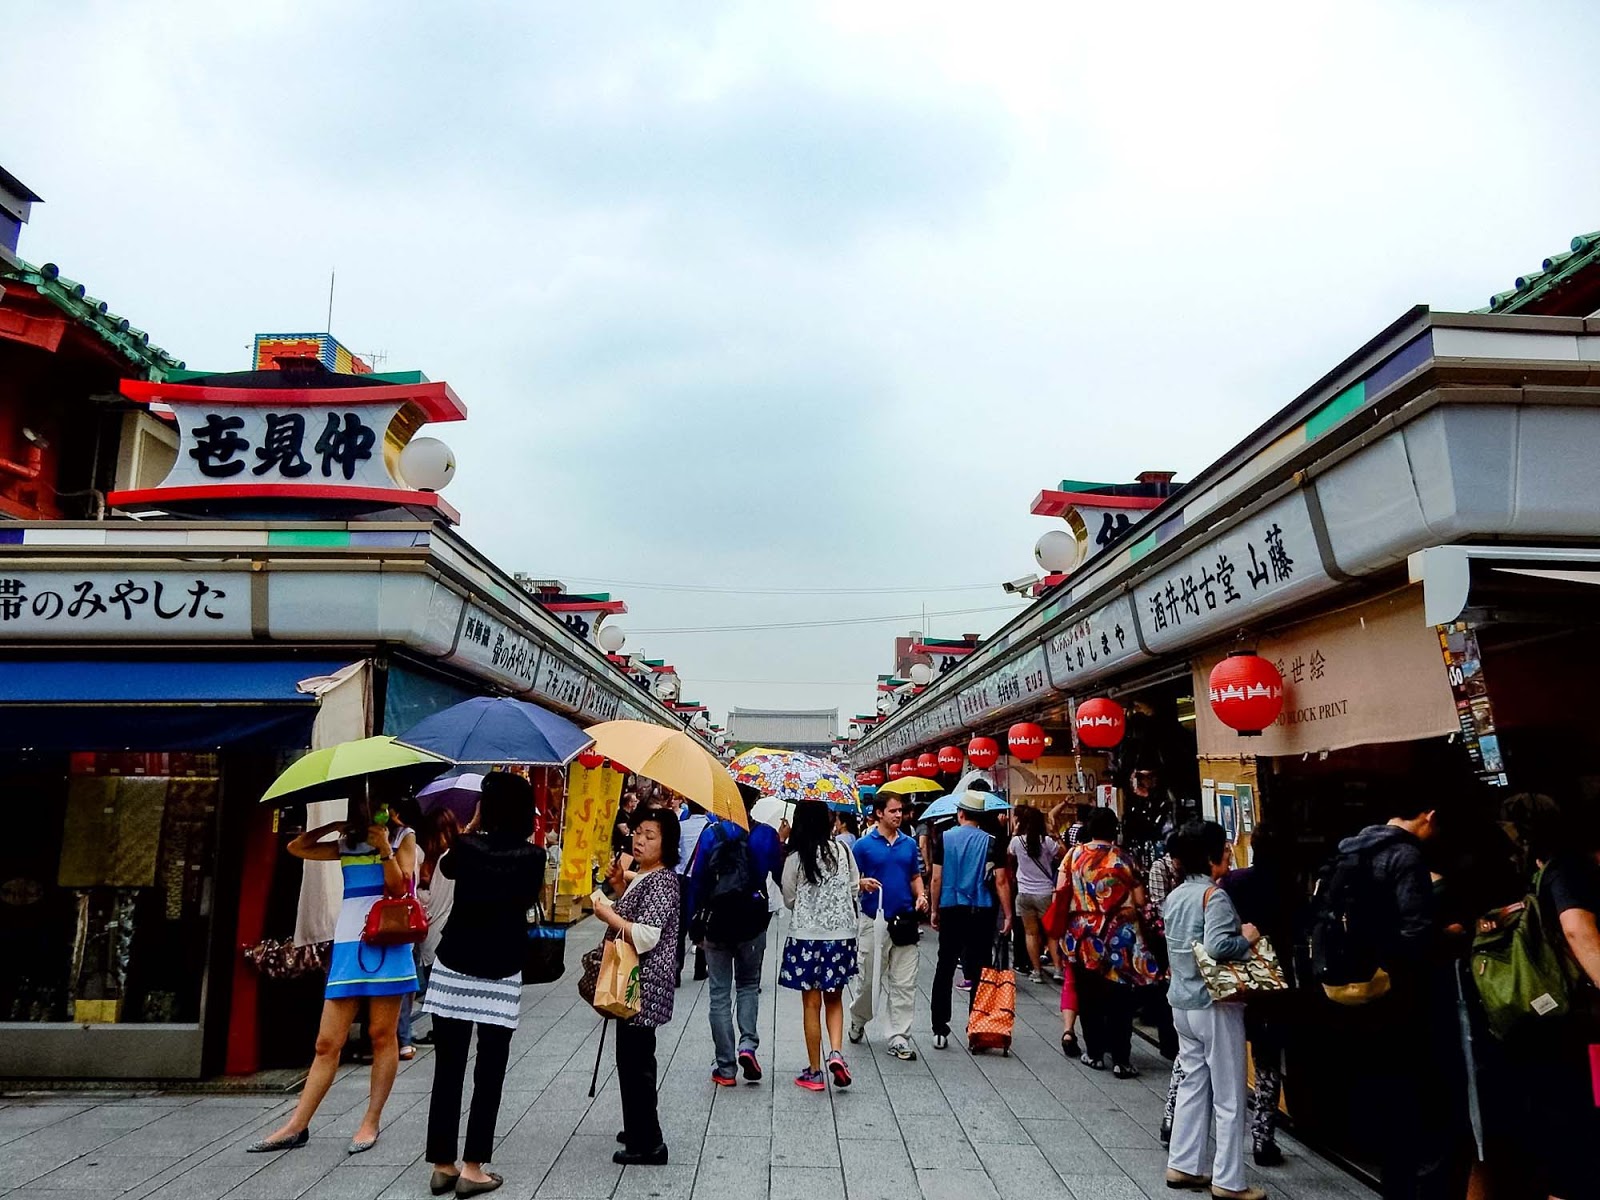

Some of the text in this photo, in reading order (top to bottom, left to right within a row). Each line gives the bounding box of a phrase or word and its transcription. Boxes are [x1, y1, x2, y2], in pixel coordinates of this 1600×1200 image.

[0, 579, 226, 621] 帯のみやした
[1149, 553, 1241, 633] 酒井好古堂
[1065, 623, 1125, 672] たかしまや
[1287, 706, 1316, 724] BLOCK
[1319, 700, 1348, 719] PRINT
